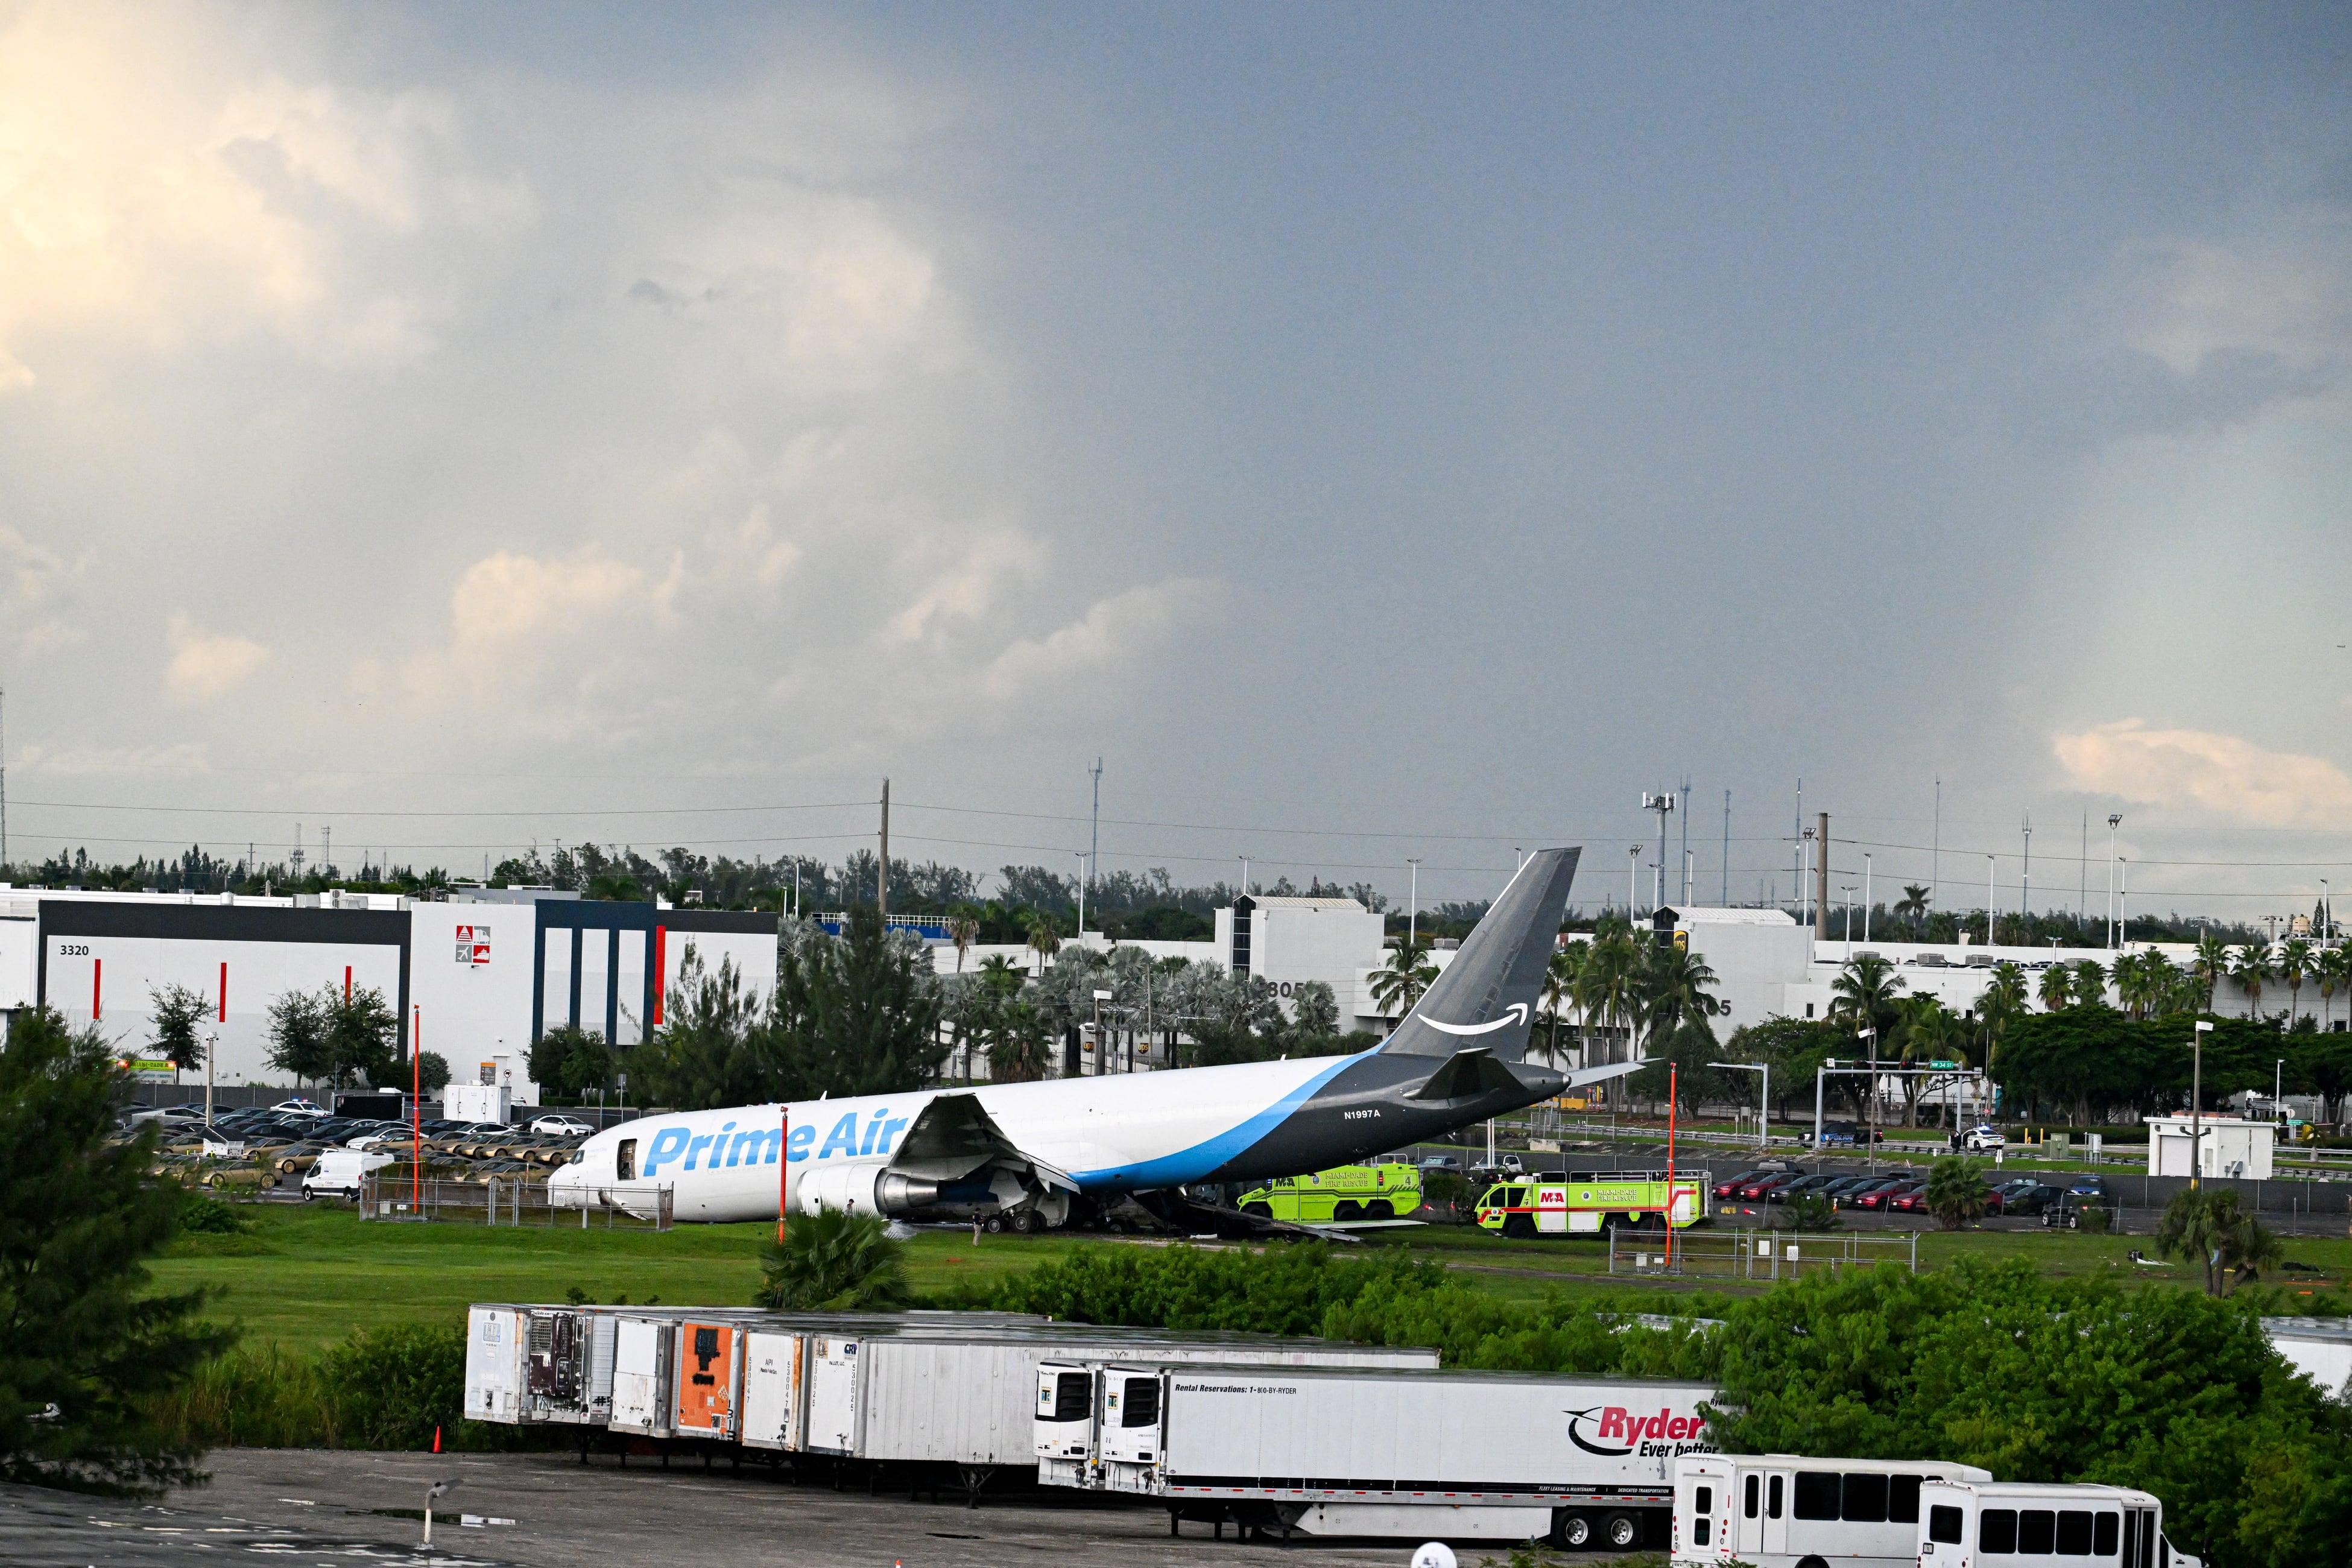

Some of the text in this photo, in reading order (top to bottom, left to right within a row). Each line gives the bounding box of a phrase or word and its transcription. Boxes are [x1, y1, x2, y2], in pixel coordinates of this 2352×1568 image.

[60, 945, 89, 956] 3320
[1083, 1042, 1094, 1051] ups
[1138, 1044, 1149, 1052] ups
[1344, 1109, 1381, 1120] N1997A
[643, 1108, 909, 1177] Prime Air
[1405, 1176, 1411, 1186] 4
[1200, 1385, 1248, 1393] Reservations:
[1598, 1406, 1706, 1446] Ryder
[1639, 1441, 1672, 1457] Ever
